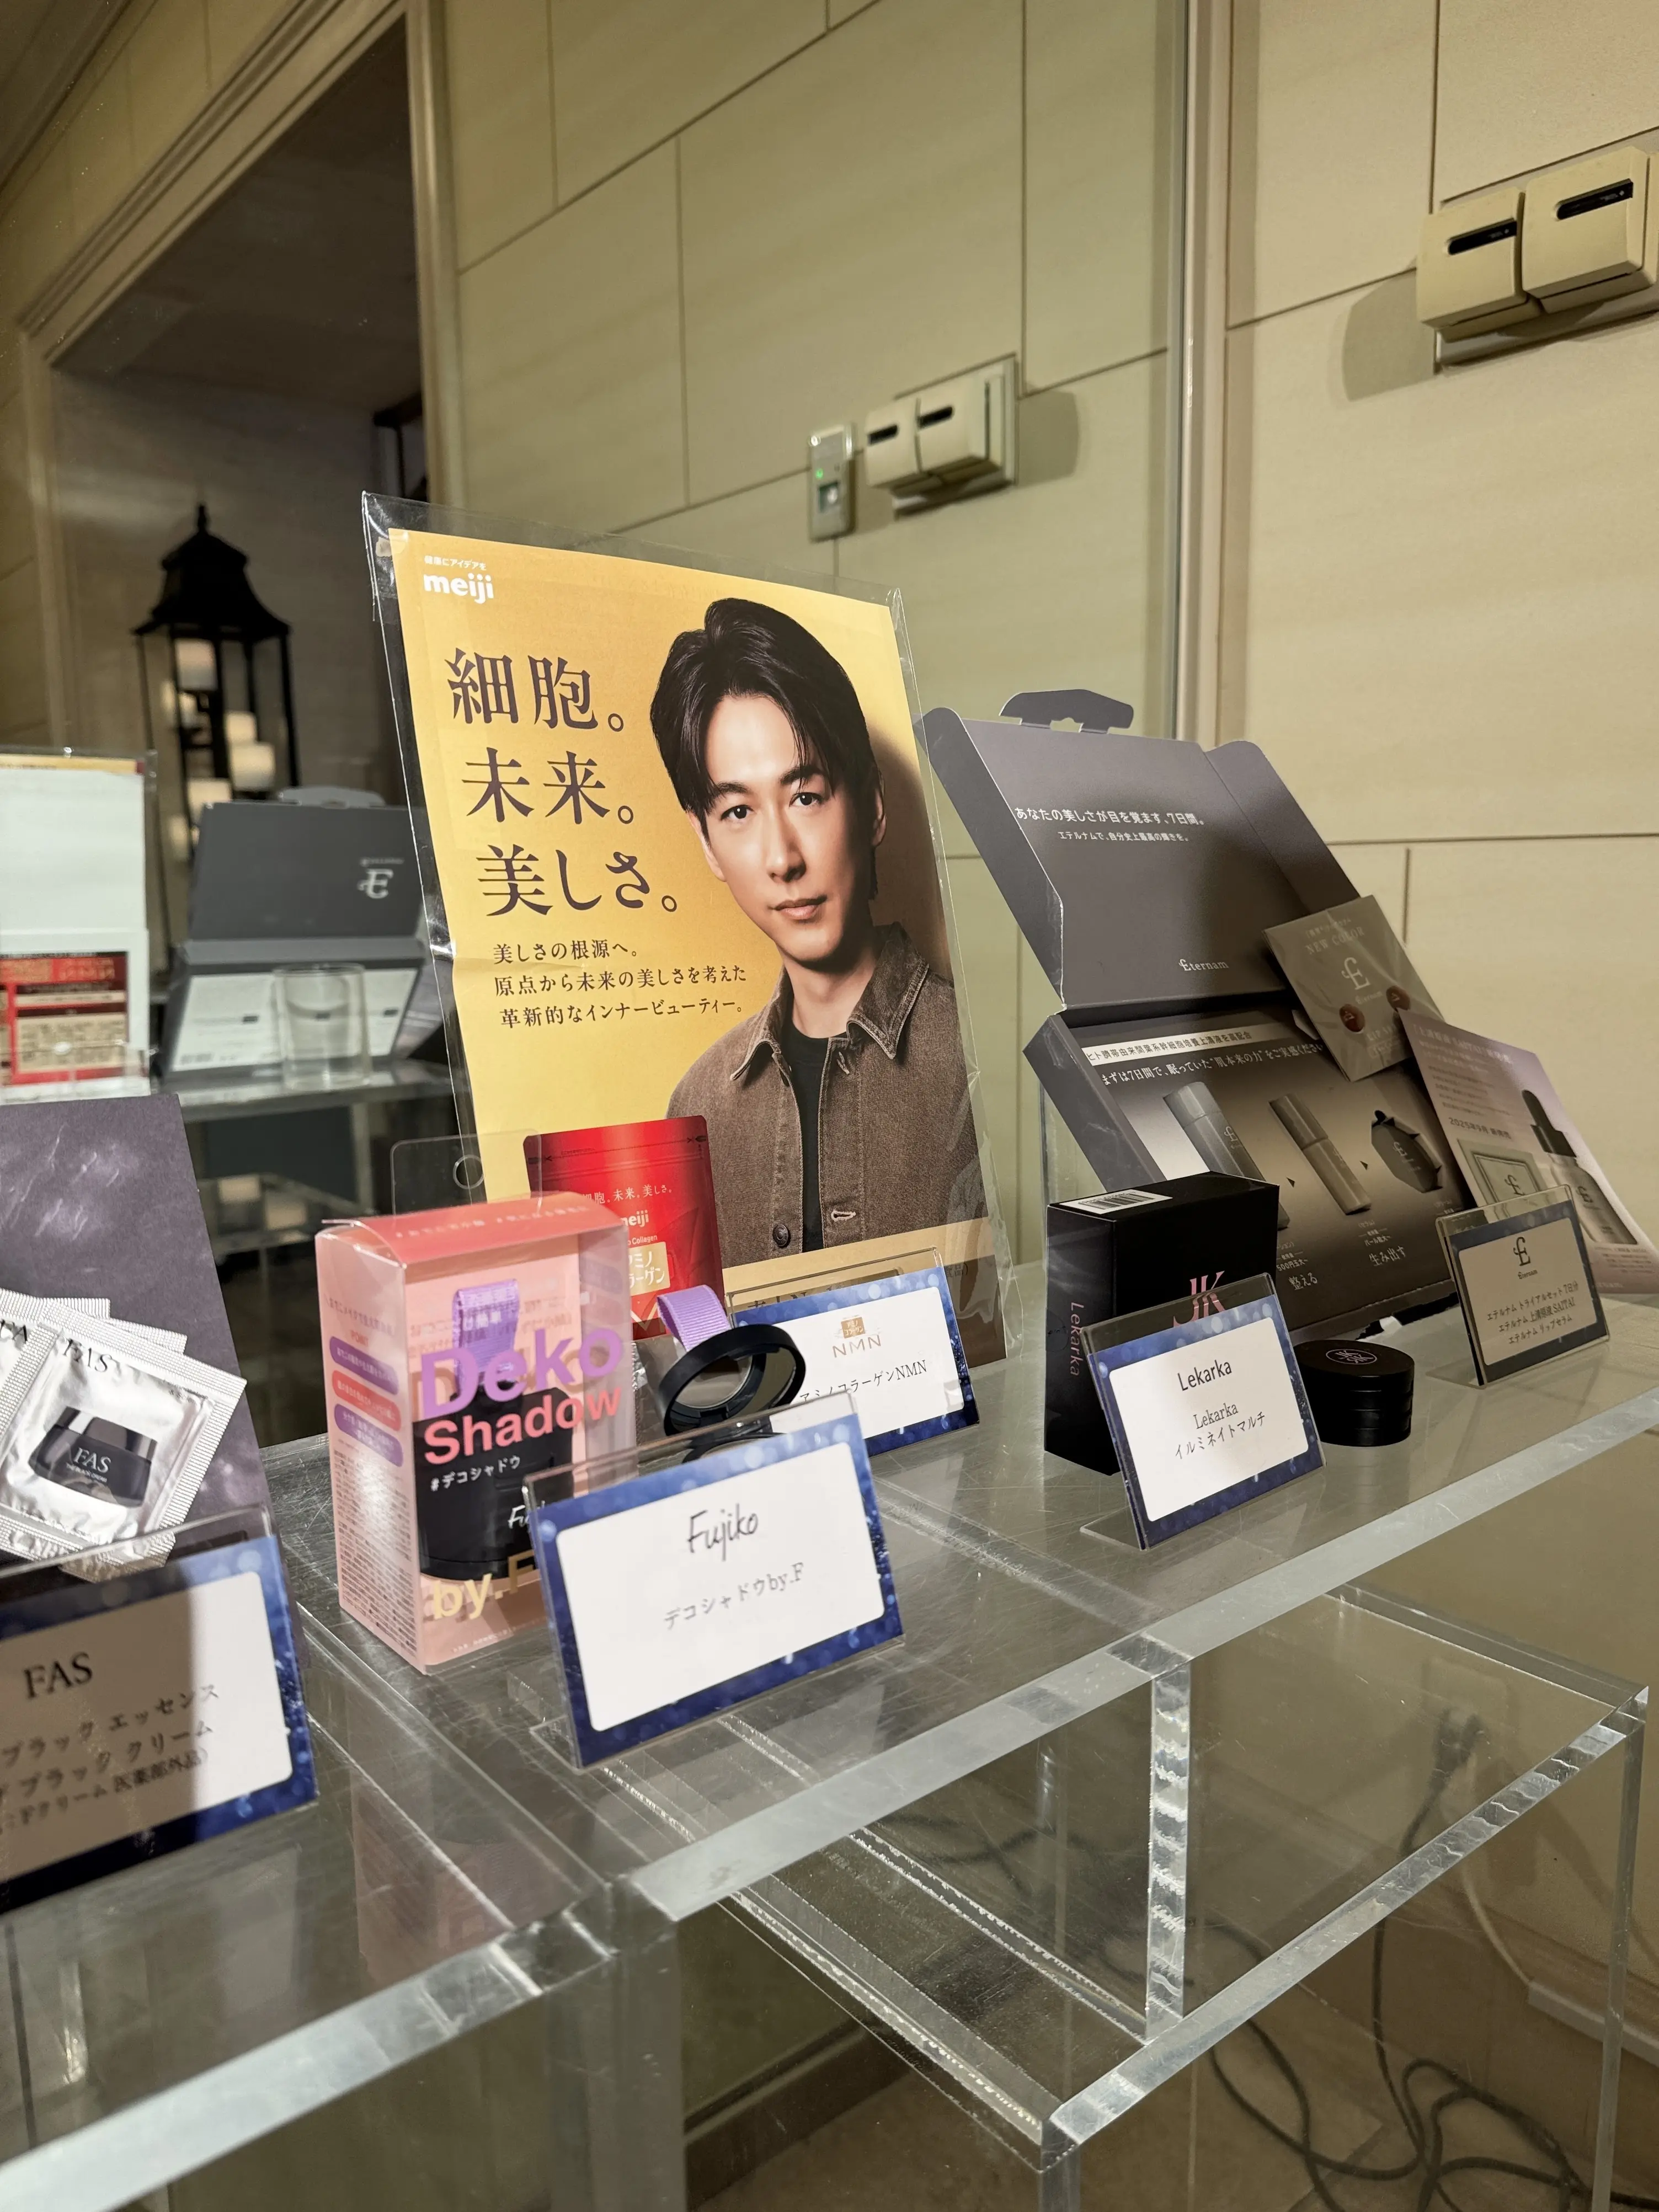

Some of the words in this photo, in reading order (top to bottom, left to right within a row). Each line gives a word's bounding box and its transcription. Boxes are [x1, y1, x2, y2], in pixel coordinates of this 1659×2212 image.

[423, 573, 494, 604] meiji
[445, 647, 624, 732] 細胞。
[462, 747, 634, 825] 未来。
[477, 844, 678, 916] 美しさ。
[493, 939, 637, 965] 美しさの根源へ。
[494, 965, 746, 996] 原点から未来の美しさを考えた
[500, 997, 743, 1028] 革新的なインナービューティー。
[1368, 1245, 1406, 1267] 生み出す
[629, 1267, 665, 1289] ラーゲン
[1288, 1272, 1318, 1291] 整える
[832, 1334, 882, 1358] NMN
[1070, 1302, 1085, 1376] Lekarka
[421, 1328, 622, 1420] Deko
[1177, 1359, 1233, 1392] Lekarka
[424, 1387, 622, 1465] Shadow
[1192, 1402, 1240, 1429] Lekarka
[1174, 1410, 1267, 1461] イルミネイトマルチ
[73, 1447, 112, 1474] FAS
[430, 1455, 521, 1492] #デコシャドウ
[686, 1503, 760, 1562] Fujiko
[664, 1562, 804, 1630] デコシャドウby.F
[23, 1652, 94, 1701] FAS
